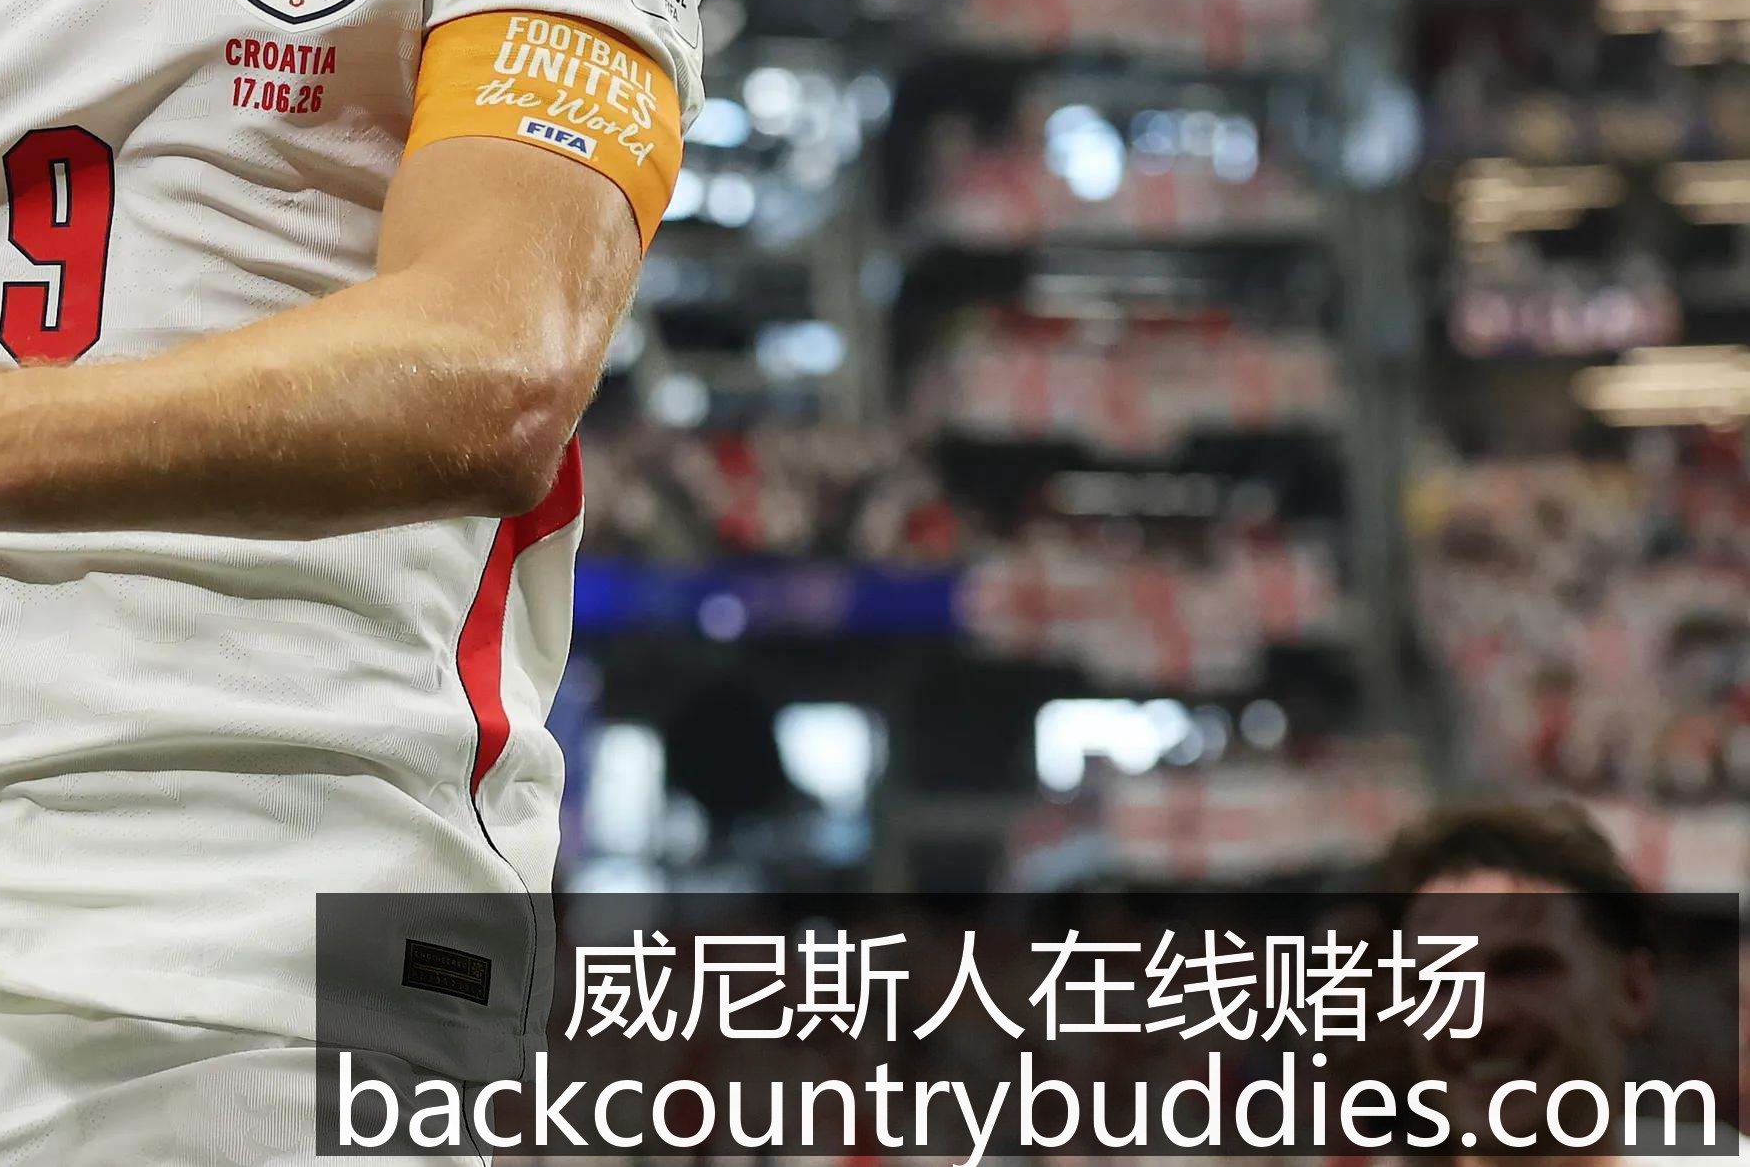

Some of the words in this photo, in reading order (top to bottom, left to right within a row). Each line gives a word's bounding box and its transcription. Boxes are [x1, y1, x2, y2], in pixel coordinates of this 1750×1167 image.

[225, 38, 336, 75] CROATIA
[493, 41, 657, 129] UNITES
[506, 17, 657, 101] FOOTBALL
[232, 76, 324, 114] 17.06.26
[475, 77, 542, 107] the
[546, 89, 655, 167] World
[526, 121, 588, 154] FIFA
